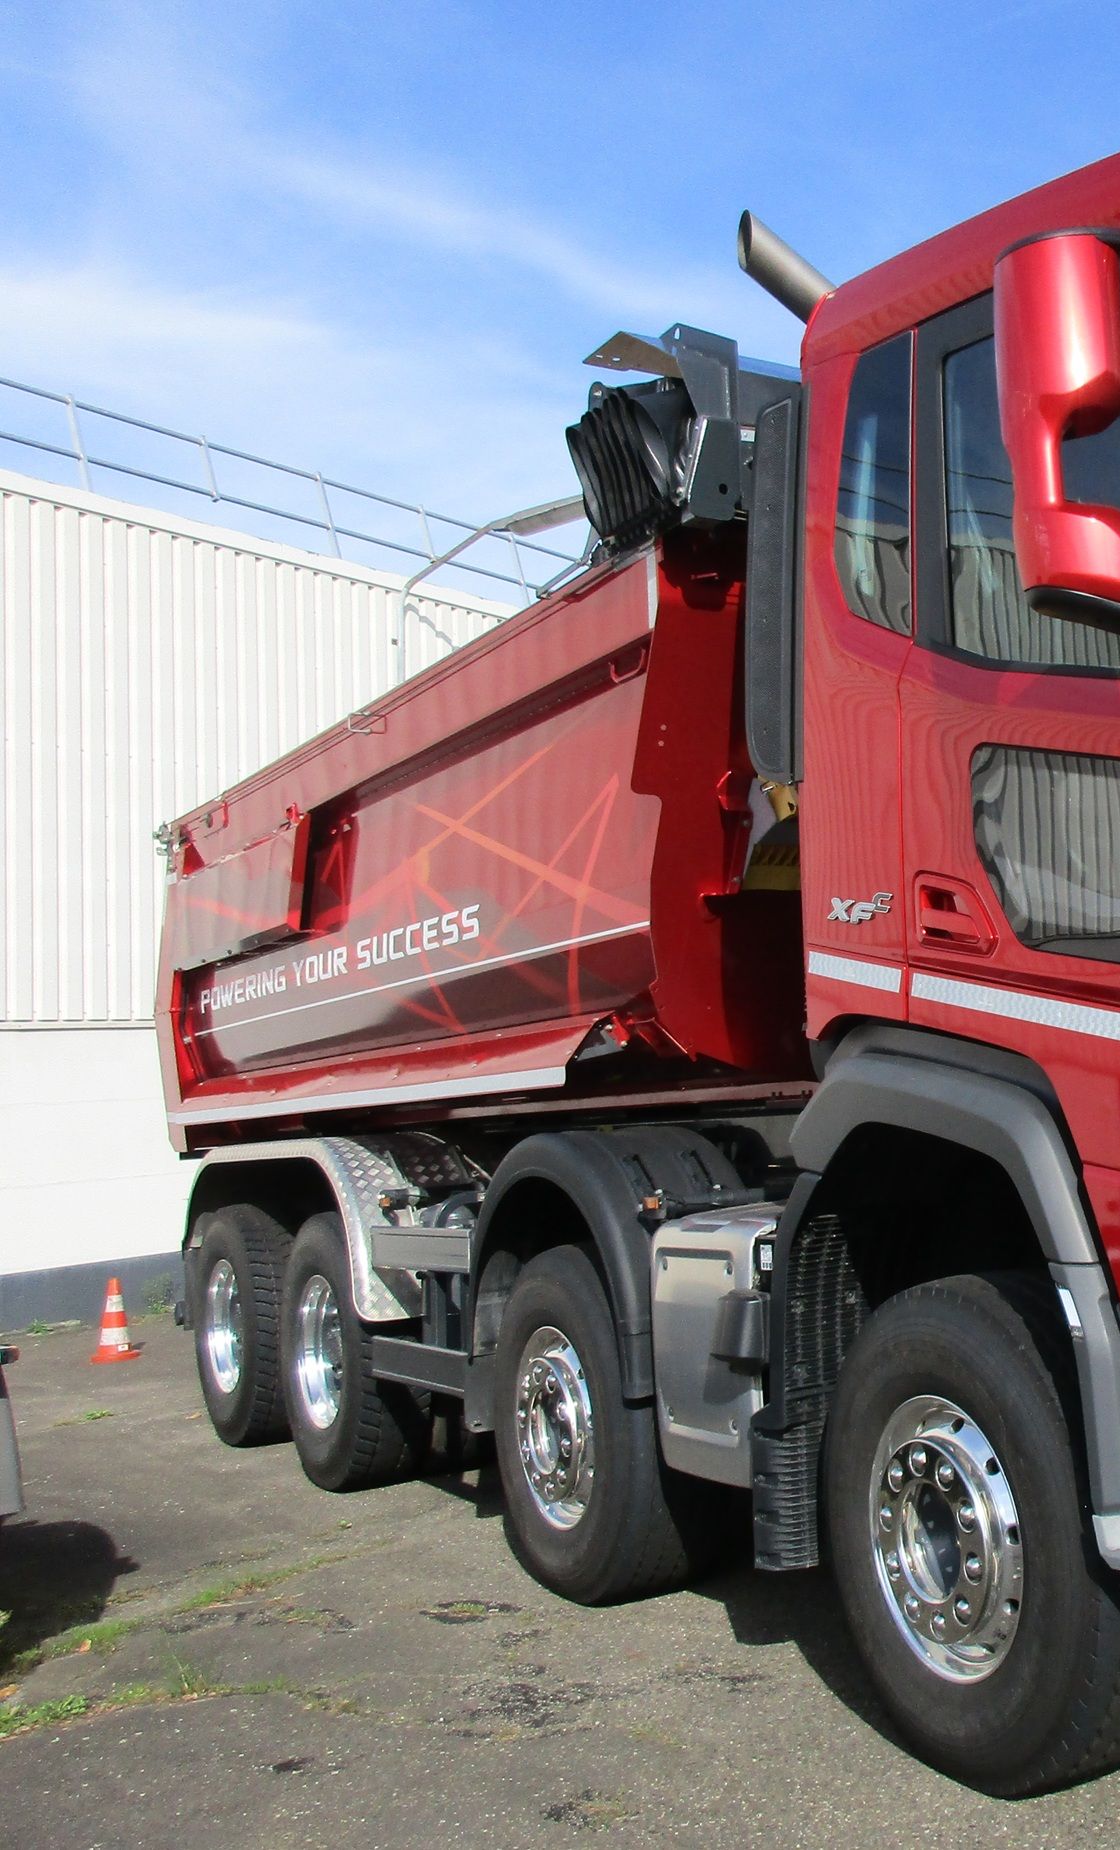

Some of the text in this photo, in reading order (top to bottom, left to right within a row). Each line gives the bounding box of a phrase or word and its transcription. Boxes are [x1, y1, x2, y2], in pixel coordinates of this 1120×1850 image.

[200, 904, 480, 1014] POWERING YOUR SUCCESS
